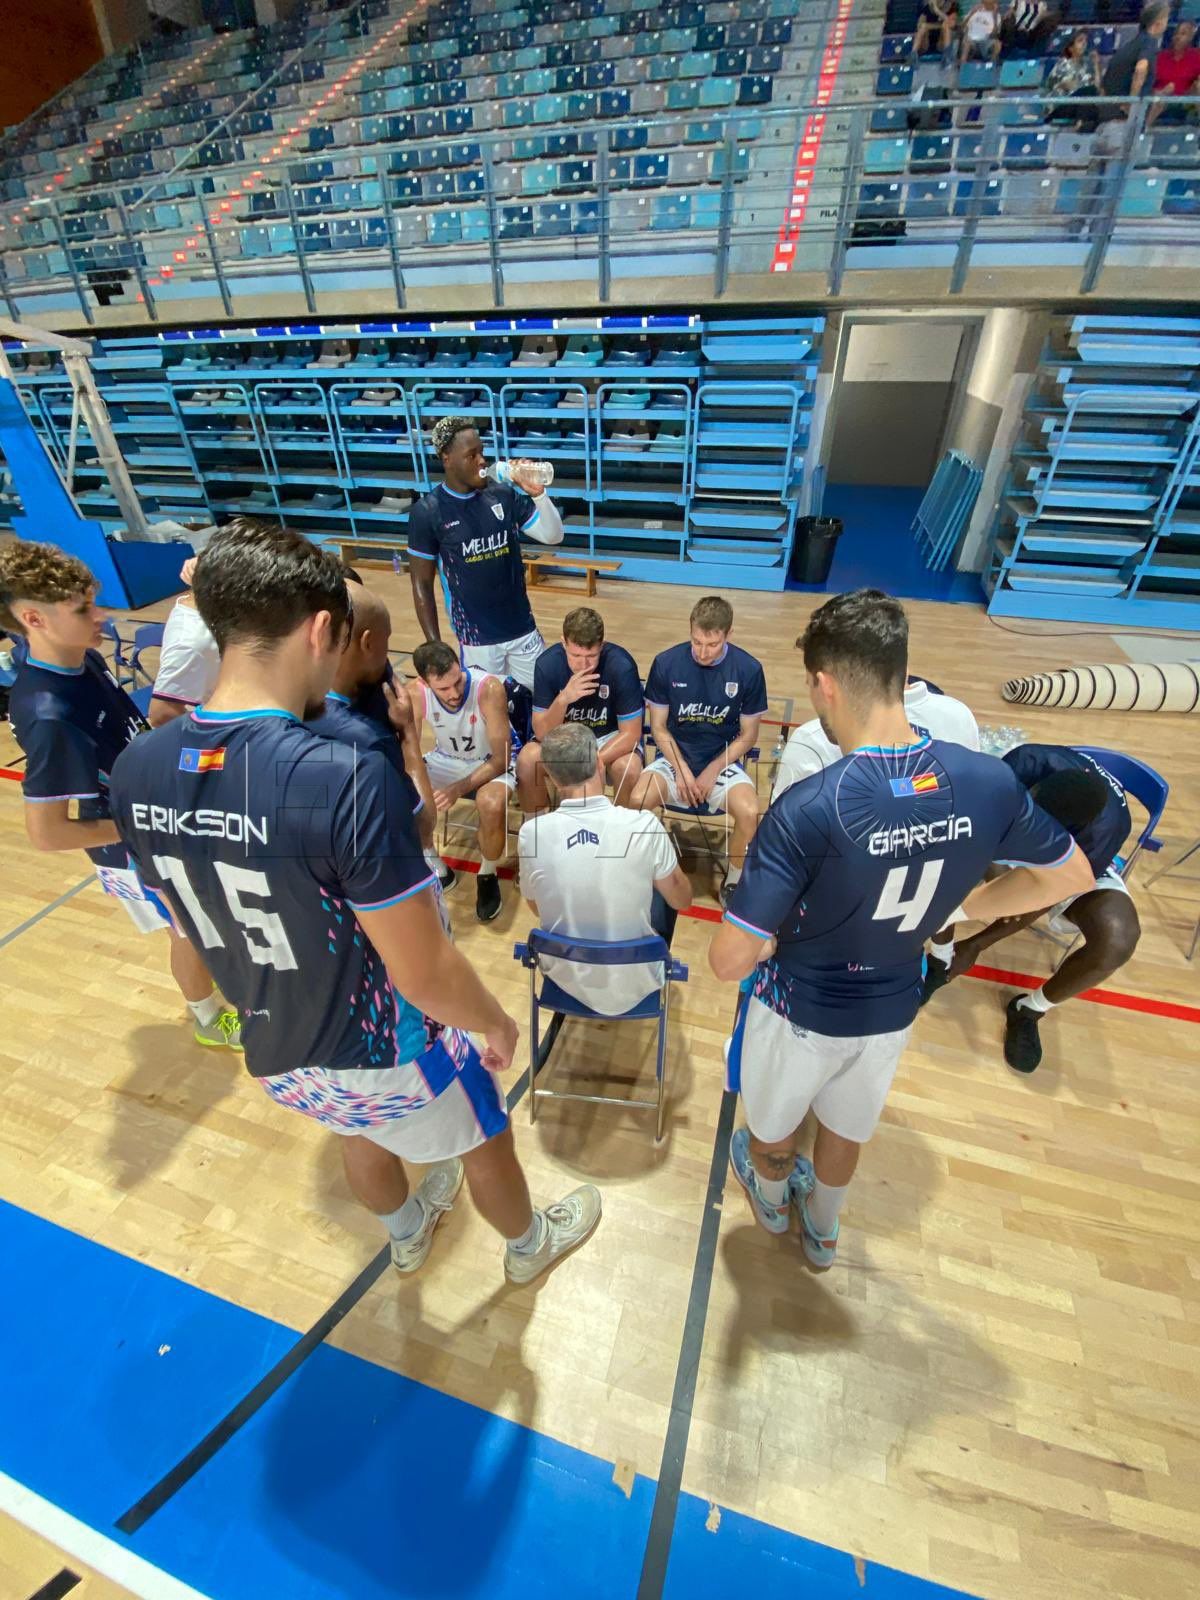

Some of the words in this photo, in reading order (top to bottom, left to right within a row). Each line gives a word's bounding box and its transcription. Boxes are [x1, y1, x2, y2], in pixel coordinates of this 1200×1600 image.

[819, 209, 838, 218] FILA
[678, 703, 731, 719] MELILLA
[449, 736, 476, 752] 12
[131, 803, 268, 845] ERIKSON
[566, 829, 600, 850] CMB
[872, 859, 945, 933] 4
[152, 854, 299, 971] 15
